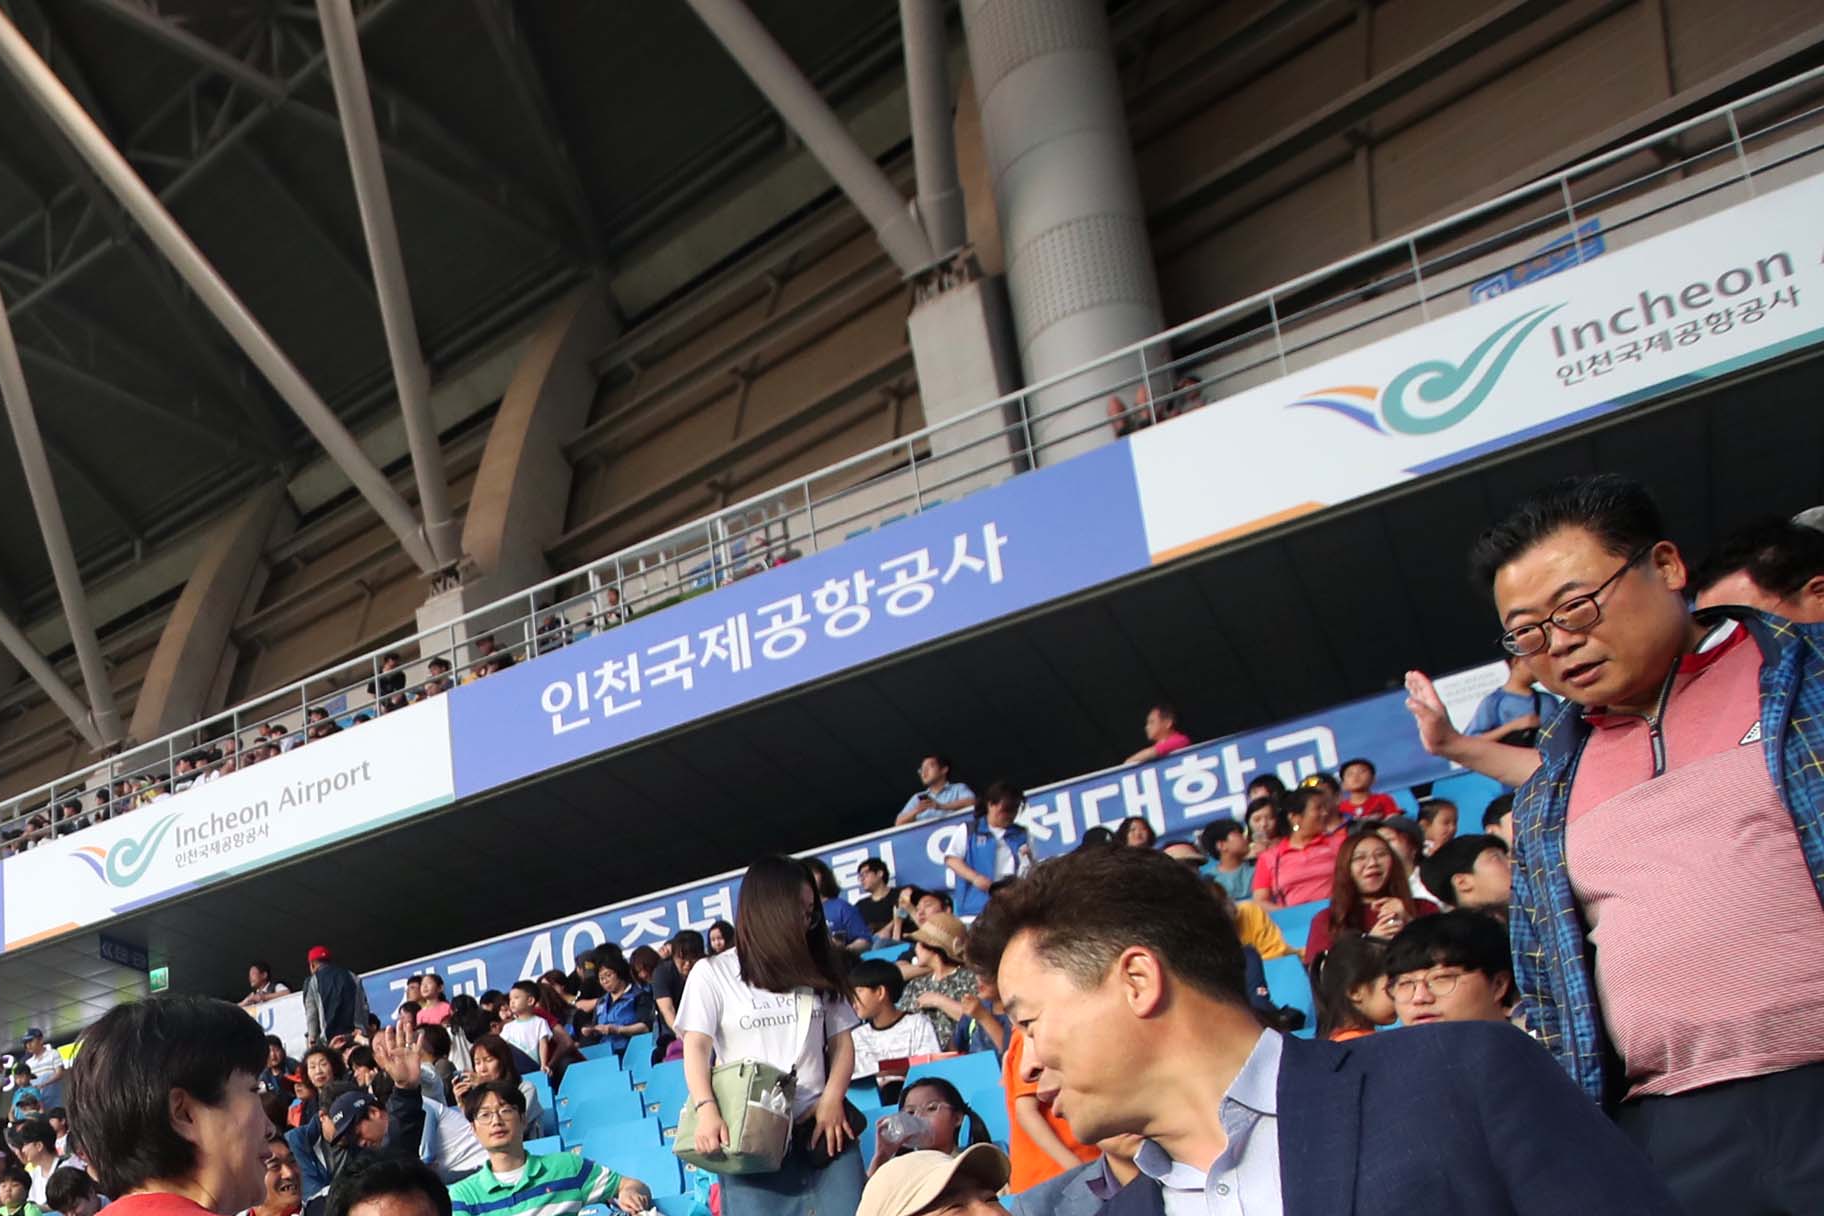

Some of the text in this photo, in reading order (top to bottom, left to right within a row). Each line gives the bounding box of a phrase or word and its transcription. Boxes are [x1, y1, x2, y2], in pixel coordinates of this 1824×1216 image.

[1551, 250, 1795, 358] Incheon
[1556, 285, 1801, 387] 인천국제공항공사
[540, 521, 1008, 736] 인천국제공항공사
[175, 823, 270, 868] 인천국제공항공사
[176, 760, 372, 848] Incheon Airport
